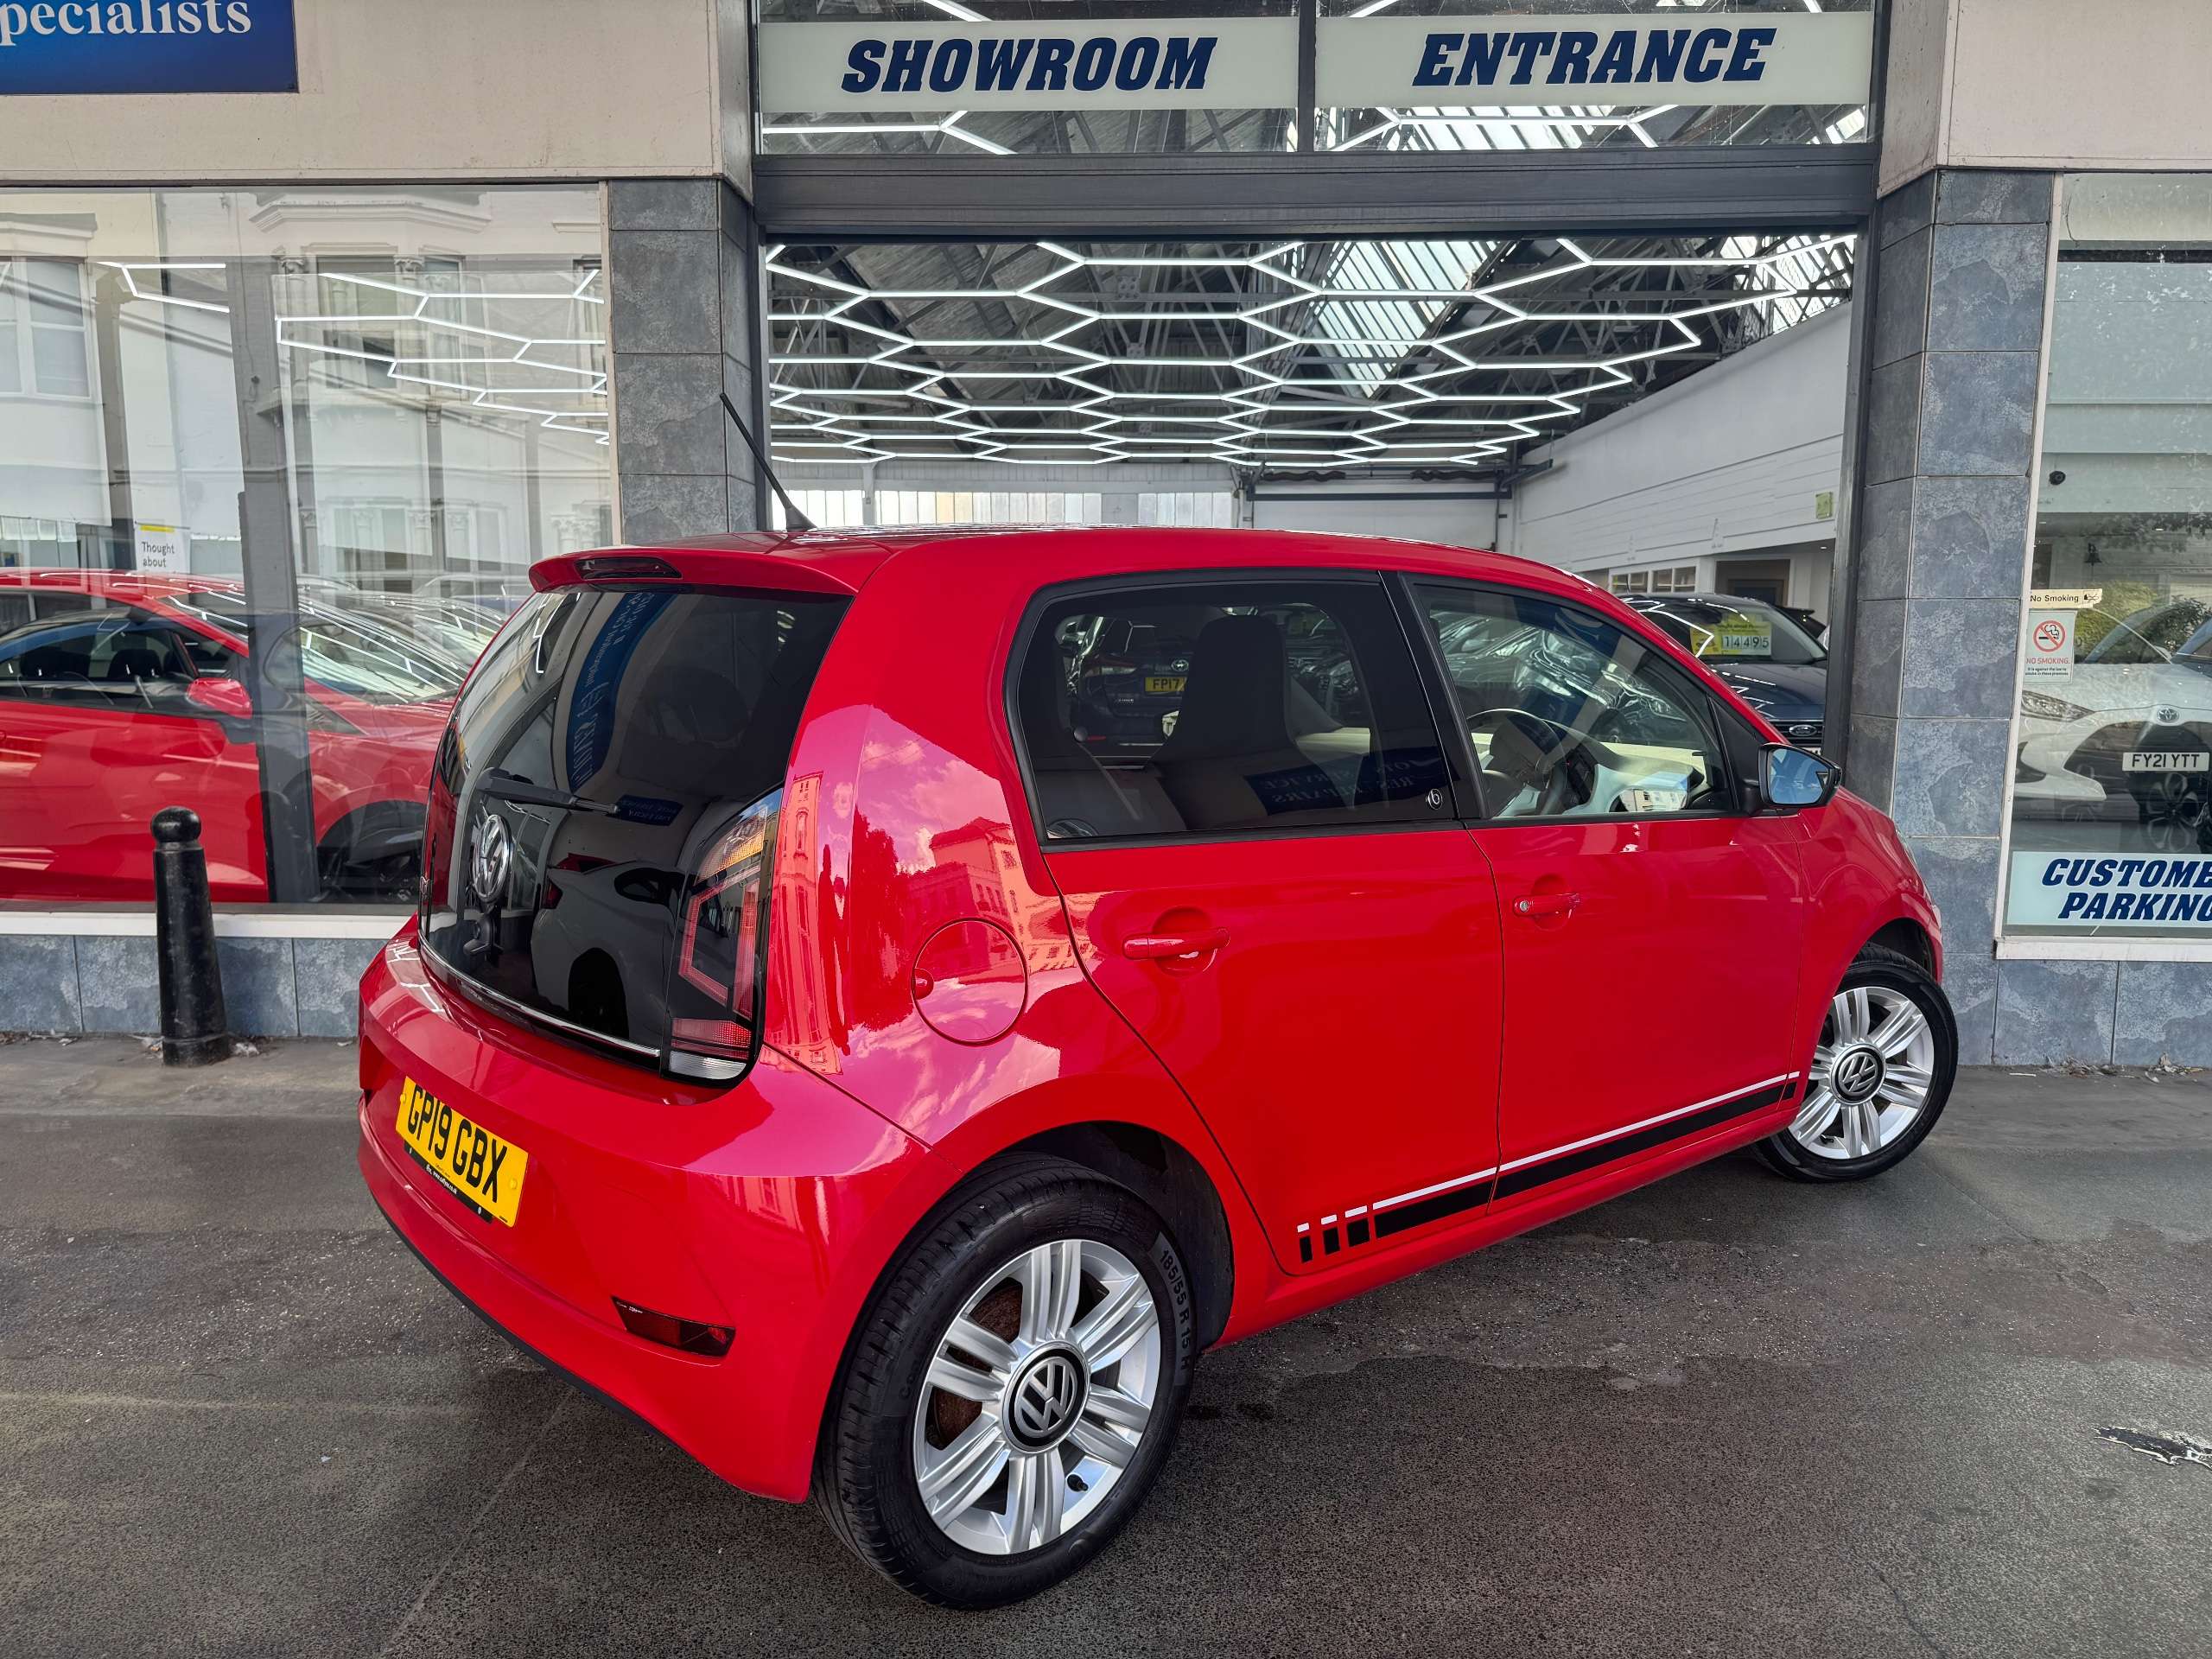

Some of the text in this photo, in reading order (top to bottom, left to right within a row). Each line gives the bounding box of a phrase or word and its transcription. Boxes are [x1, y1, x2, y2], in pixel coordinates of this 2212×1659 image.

[841, 27, 1777, 93] SHOWROOM ENTRANCE
[141, 541, 175, 556] Thought
[143, 556, 167, 568] about
[2044, 594, 2079, 603] Smoking
[1725, 635, 1770, 649] 14495
[1152, 678, 1180, 690] FP17
[2132, 753, 2201, 768] FY21 YTT
[2041, 858, 2212, 888] CUSTOME
[407, 1084, 508, 1204] GP19 GBX
[1160, 1249, 1191, 1370] 185/55 R 15 H
